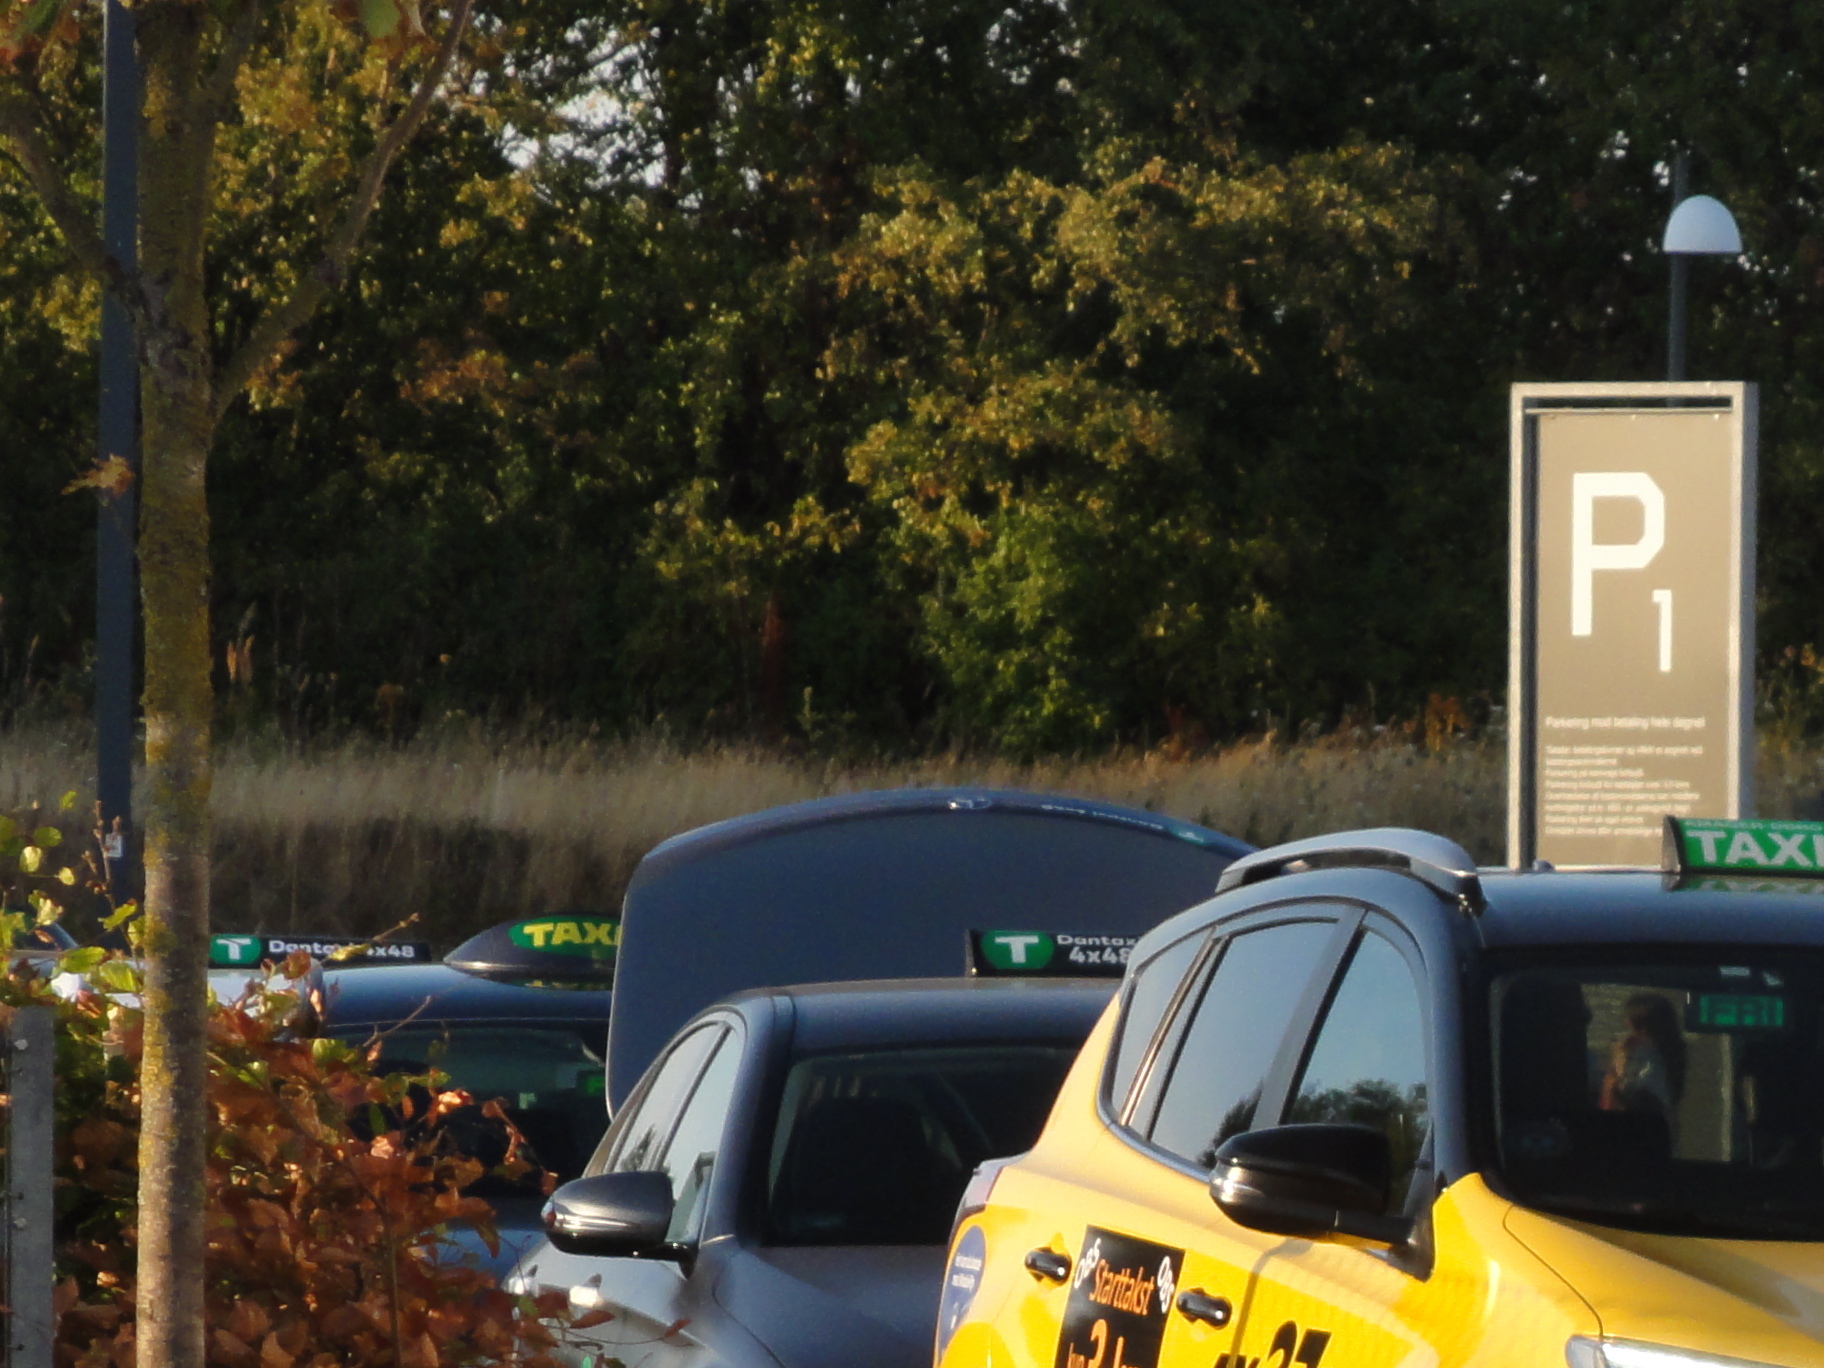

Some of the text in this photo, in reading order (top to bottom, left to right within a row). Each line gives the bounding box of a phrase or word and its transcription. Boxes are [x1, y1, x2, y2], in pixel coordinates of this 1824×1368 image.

[1571, 472, 1673, 673] P 1
[215, 937, 252, 961] T
[994, 935, 1040, 964] T
[1088, 1258, 1155, 1316] Starttakst
